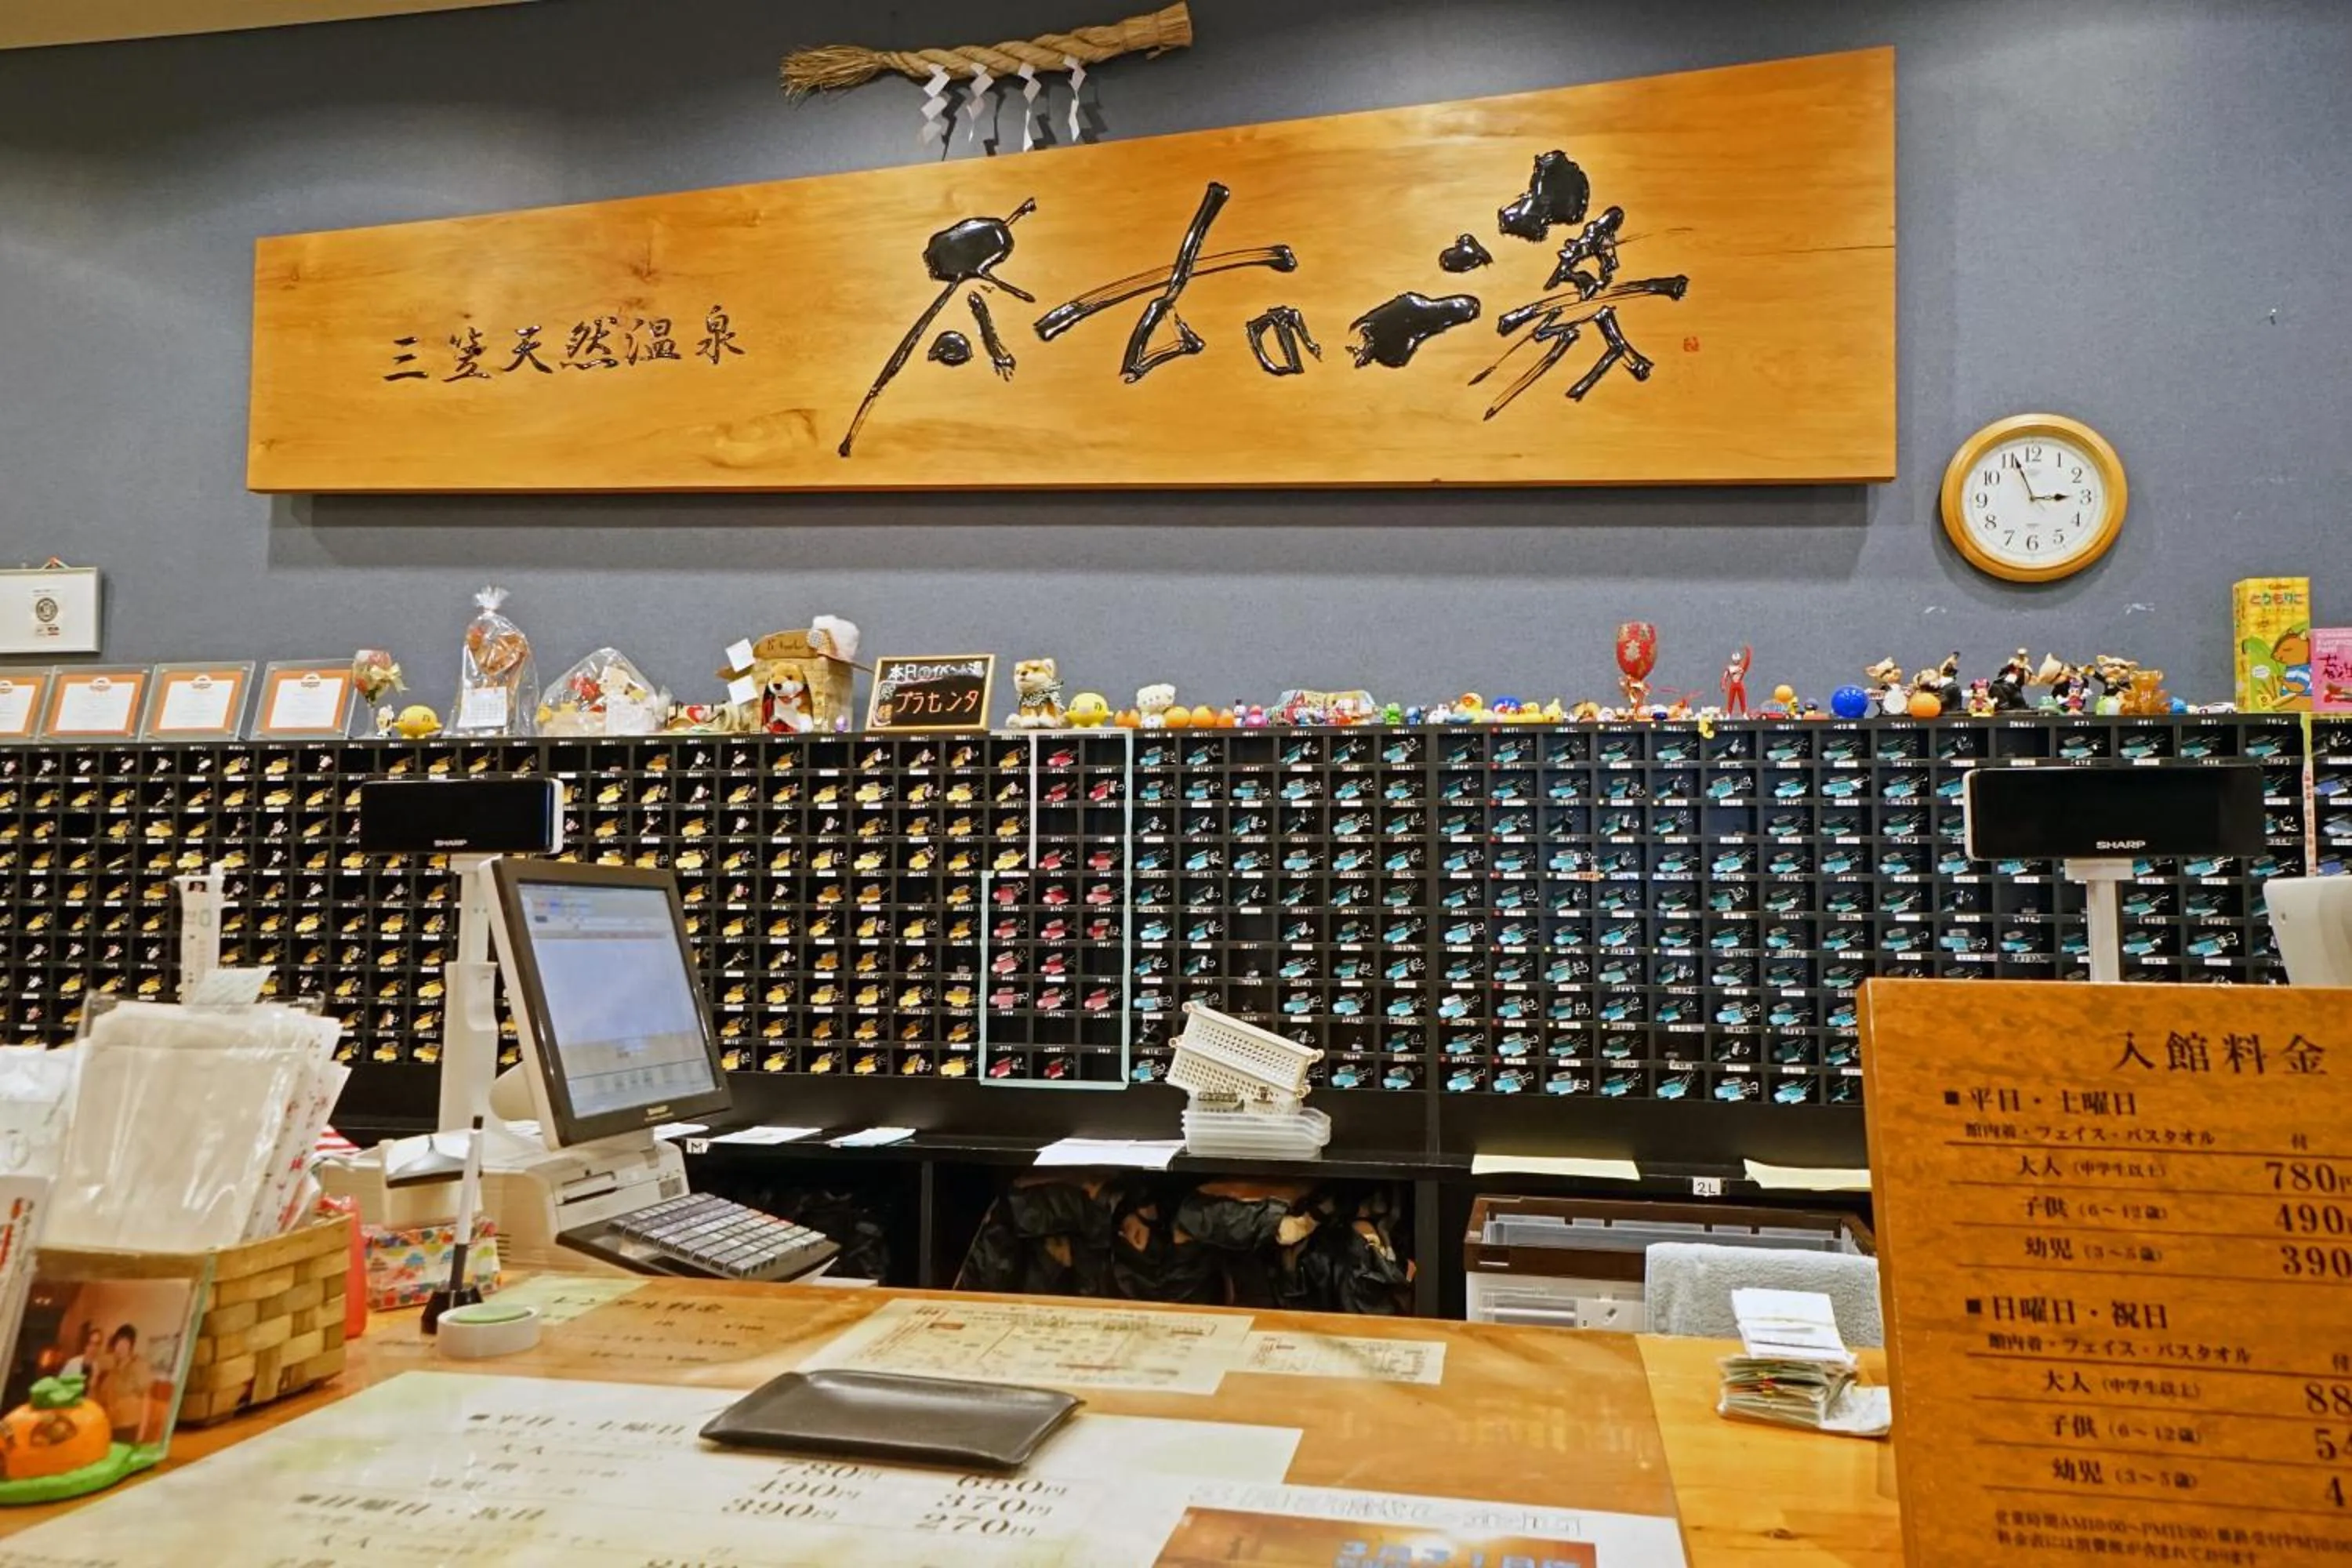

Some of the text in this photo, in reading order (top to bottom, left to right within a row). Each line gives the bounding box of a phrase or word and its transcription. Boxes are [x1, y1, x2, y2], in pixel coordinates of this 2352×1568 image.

[382, 303, 745, 383] 三笠天然温泉
[2002, 452, 2015, 469] 11
[2025, 446, 2042, 463] 12
[1984, 470, 2000, 487] 10
[2071, 467, 2082, 484] 2
[1976, 492, 1987, 509] 9
[2080, 489, 2092, 505] 3
[1984, 514, 1997, 530] 8
[2071, 511, 2080, 527] 4
[2004, 530, 2015, 546] 7
[2026, 535, 2038, 550] 6
[2053, 528, 2064, 545] 5
[895, 690, 979, 714] プラセンタ
[2096, 840, 2147, 850] SHARP
[2109, 1031, 2327, 1075] 入館料金
[1969, 1087, 2136, 1116] 平日・土曜日
[2019, 1154, 2062, 1177] 大人
[1697, 1181, 1716, 1194] 2L
[2025, 1196, 2068, 1218] 子供
[2025, 1236, 2073, 1261] 幼児
[1993, 1295, 2169, 1329] 日曜日・祝日
[2045, 1369, 2091, 1394] 大人
[2052, 1414, 2097, 1439] 子供
[2052, 1457, 2103, 1485] 幼児
